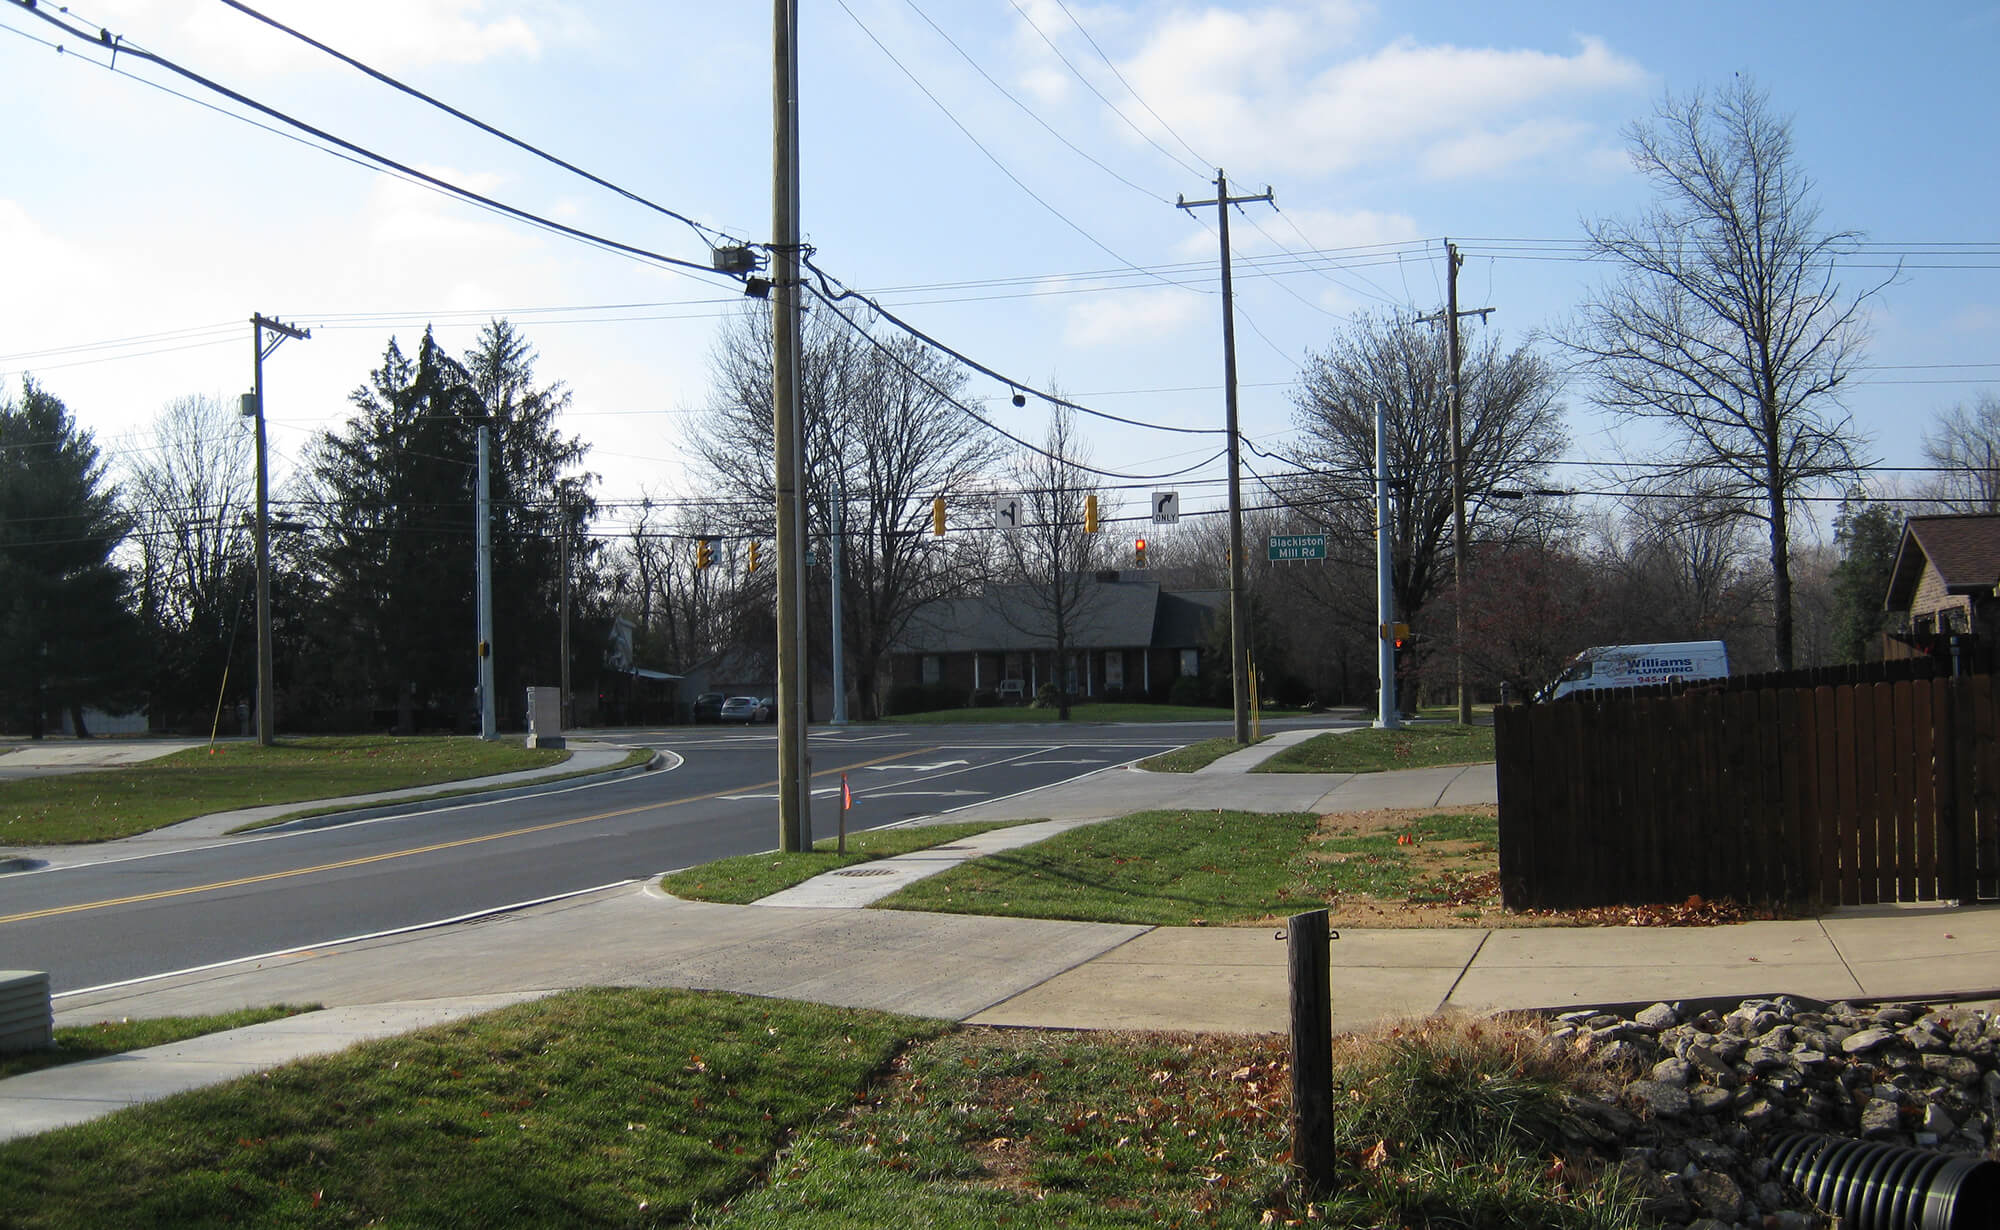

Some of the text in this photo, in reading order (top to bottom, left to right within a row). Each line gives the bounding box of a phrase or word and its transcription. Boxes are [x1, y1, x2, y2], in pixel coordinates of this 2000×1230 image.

[1155, 513, 1176, 523] ONLY
[1270, 537, 1323, 548] Blackiston
[1280, 547, 1315, 558] Mill Rd
[1626, 658, 1692, 667] Williams
[1627, 666, 1693, 674] PLUMBING
